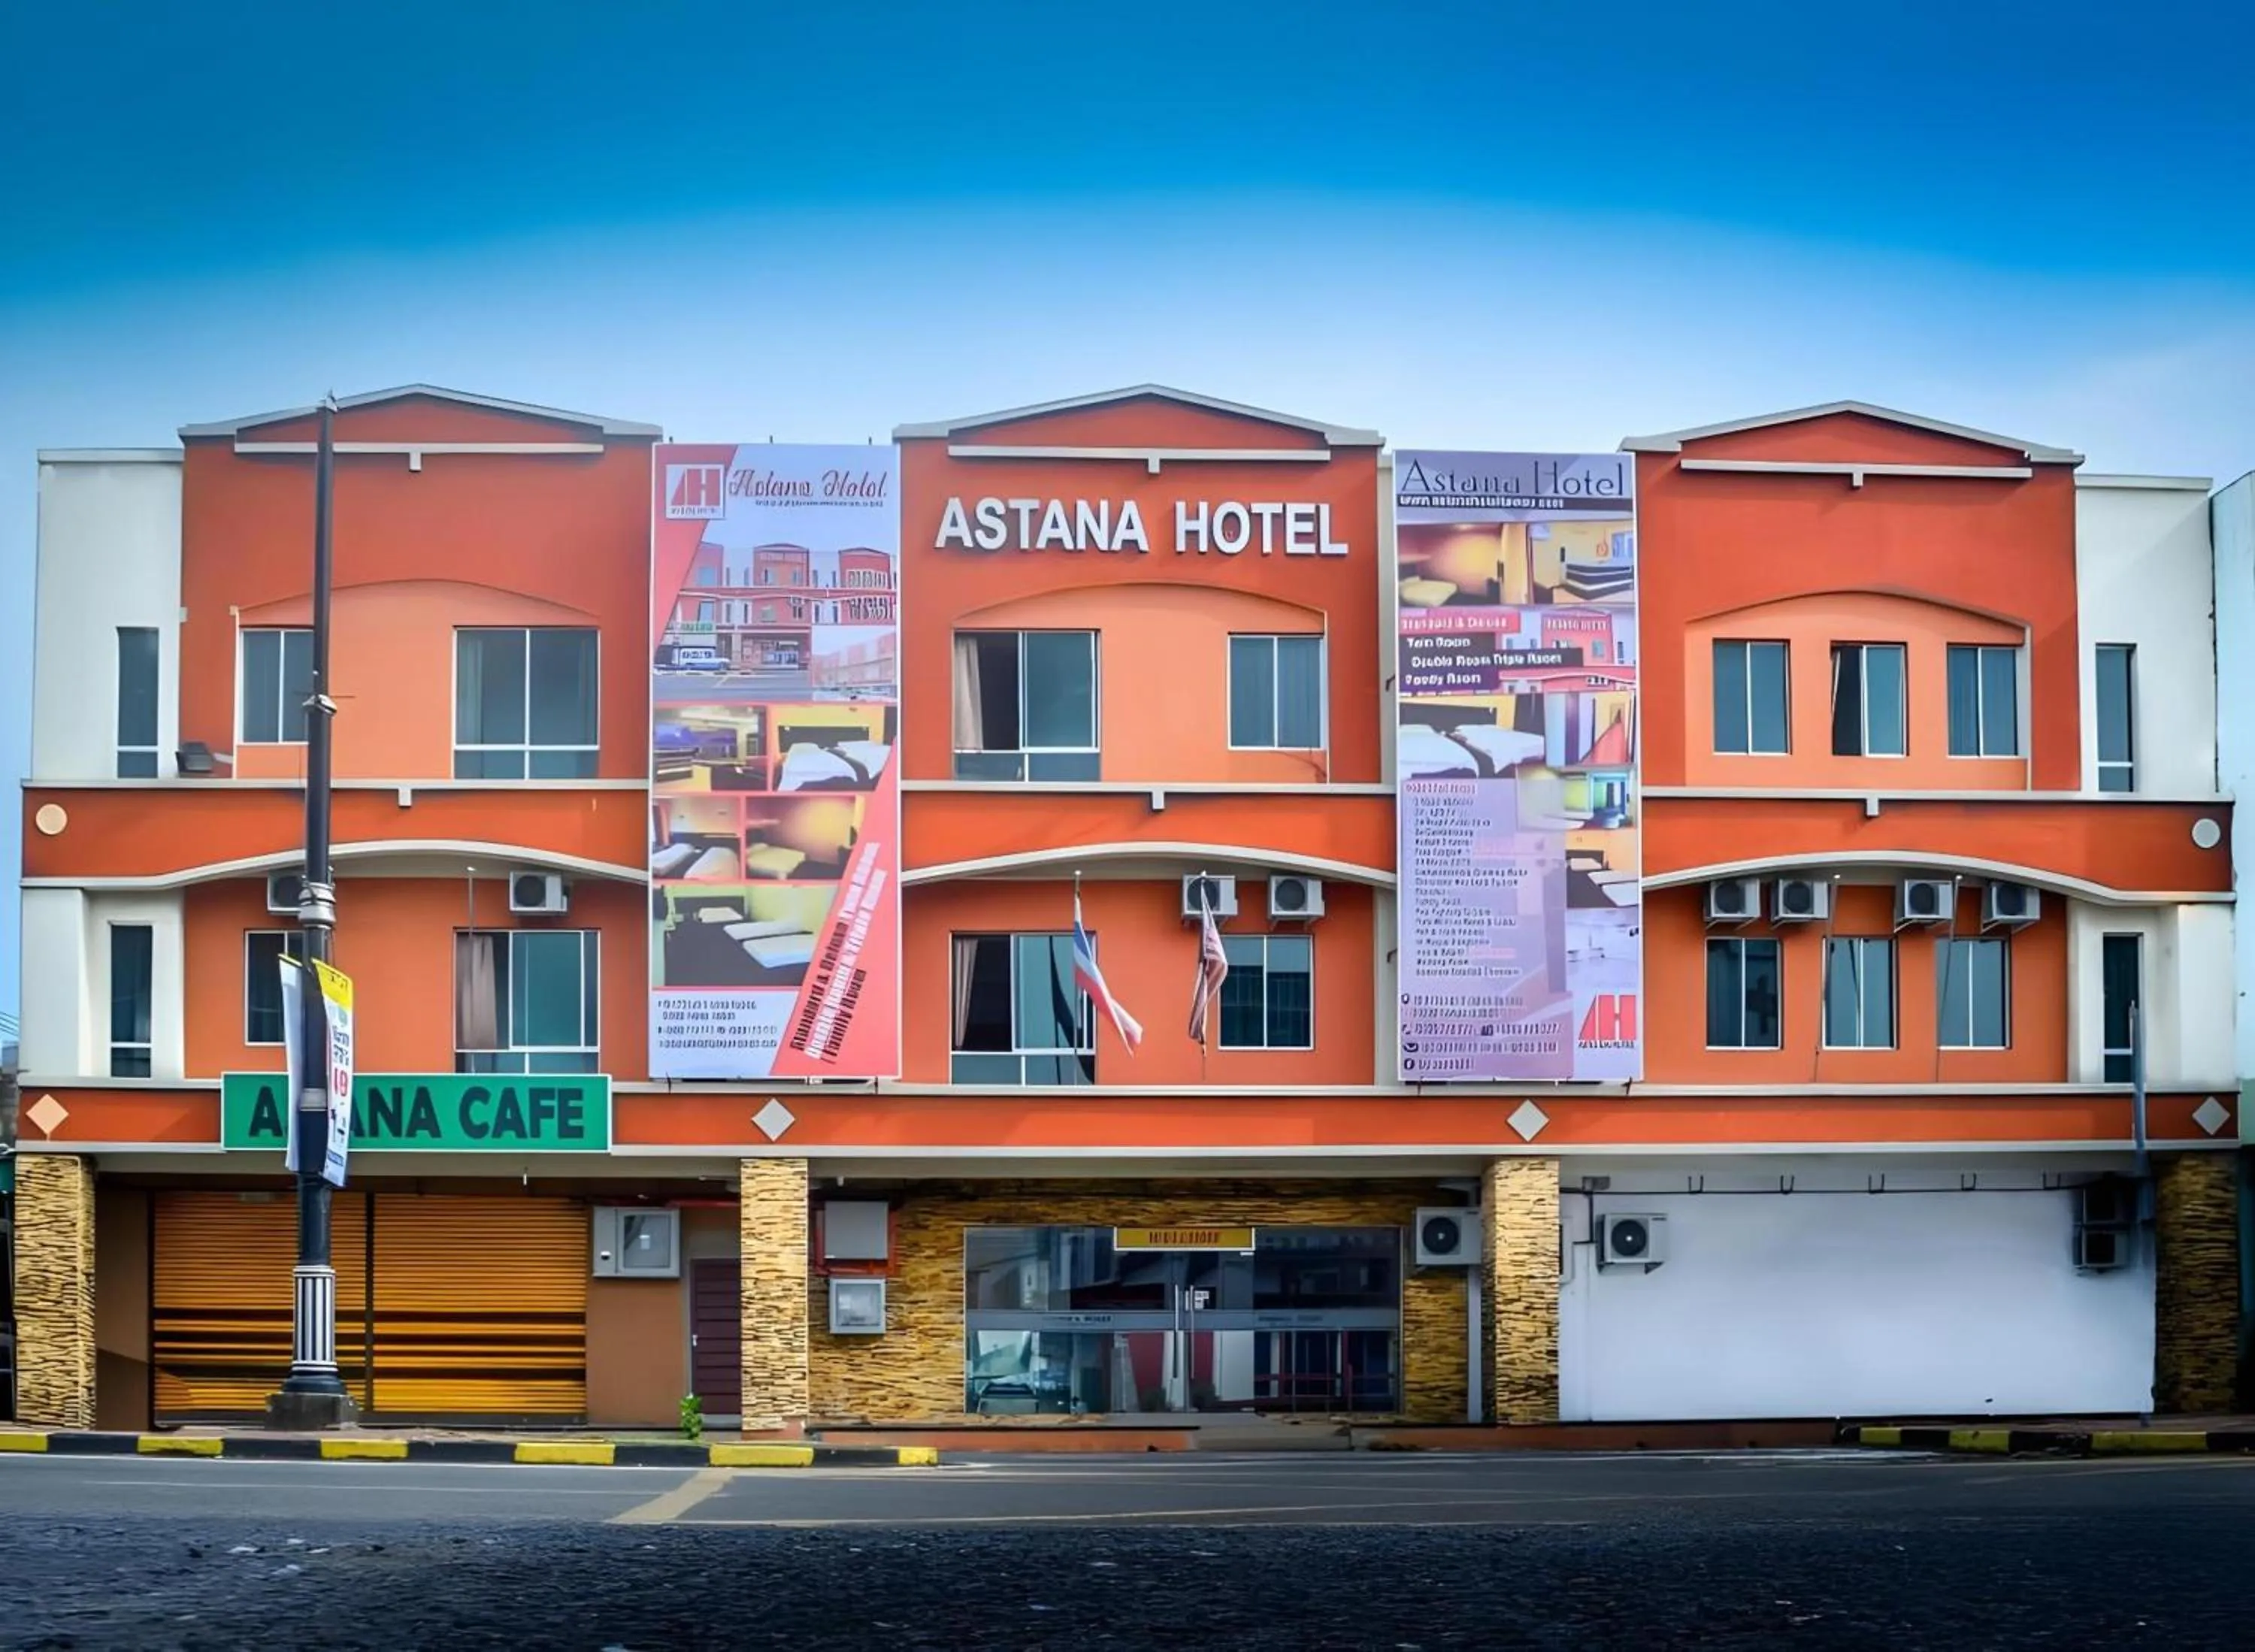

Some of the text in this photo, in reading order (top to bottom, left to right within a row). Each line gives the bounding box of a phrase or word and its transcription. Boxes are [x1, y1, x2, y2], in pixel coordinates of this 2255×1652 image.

[1534, 460, 1624, 496] Hotel
[934, 497, 1349, 555] ASTANA HOTEL
[459, 1086, 584, 1139] CAFE
